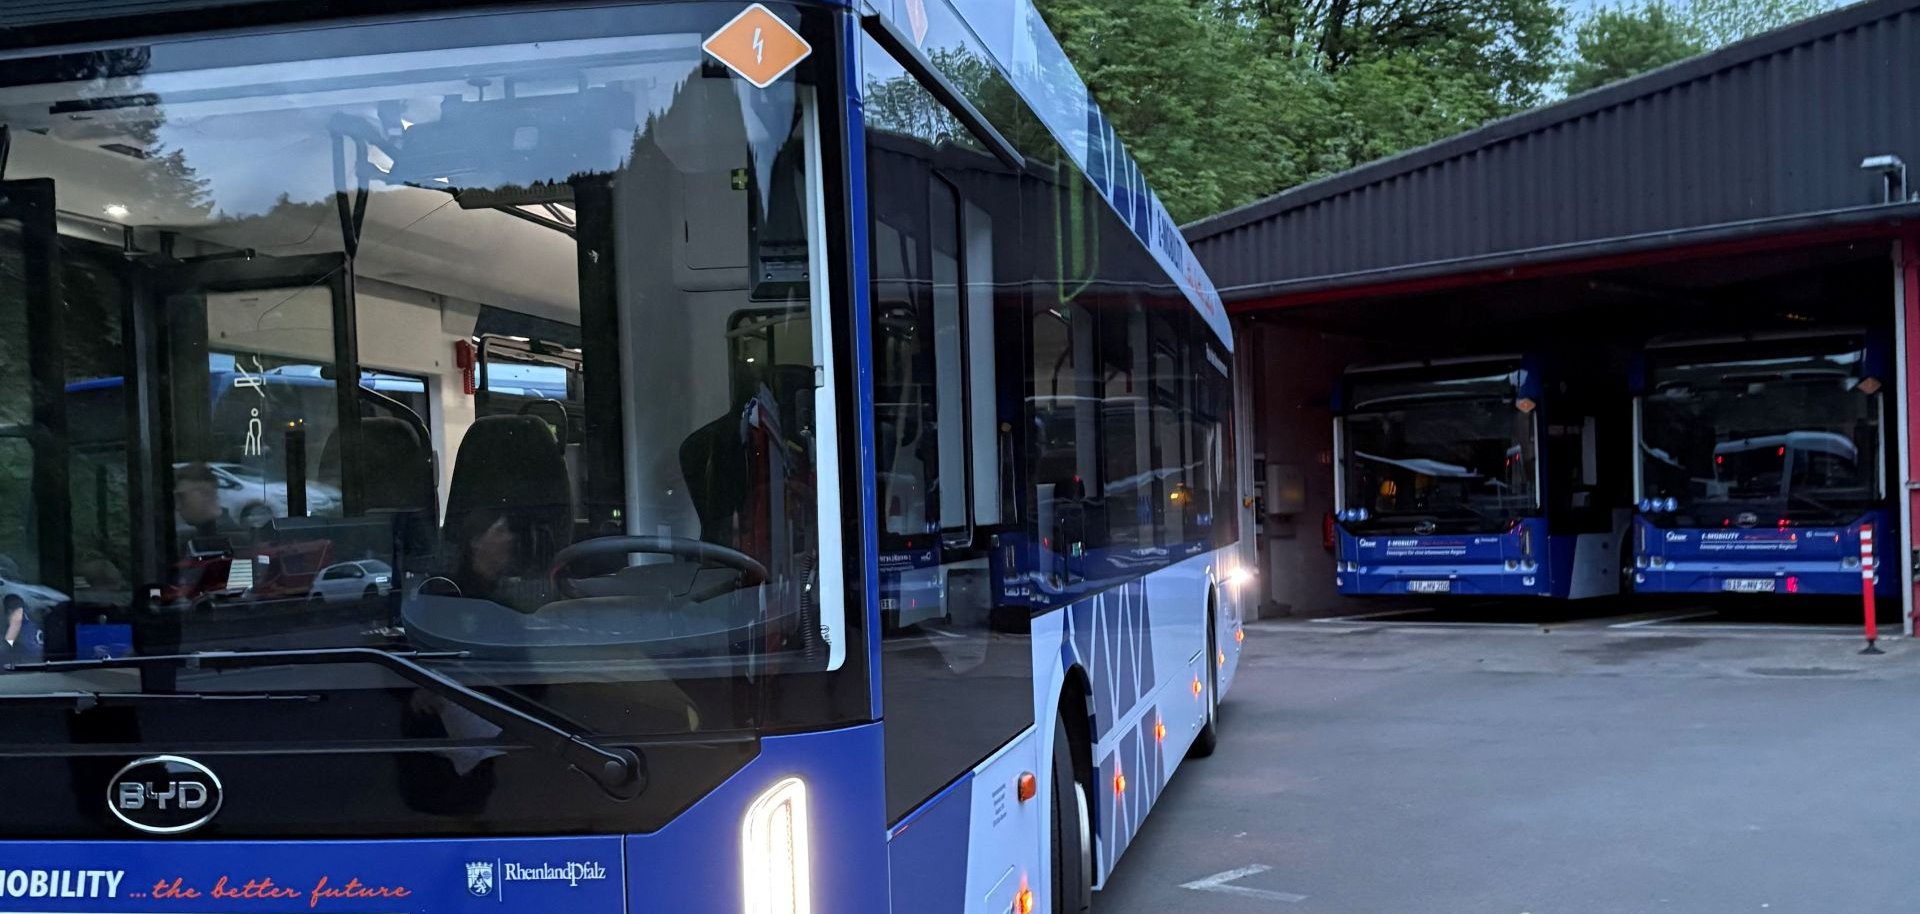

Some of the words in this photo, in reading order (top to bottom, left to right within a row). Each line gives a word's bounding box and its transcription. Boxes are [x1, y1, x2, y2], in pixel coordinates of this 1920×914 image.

[120, 781, 208, 810] BYD
[0, 869, 125, 898] OBILITY
[210, 875, 301, 899] better
[310, 876, 411, 908] future
